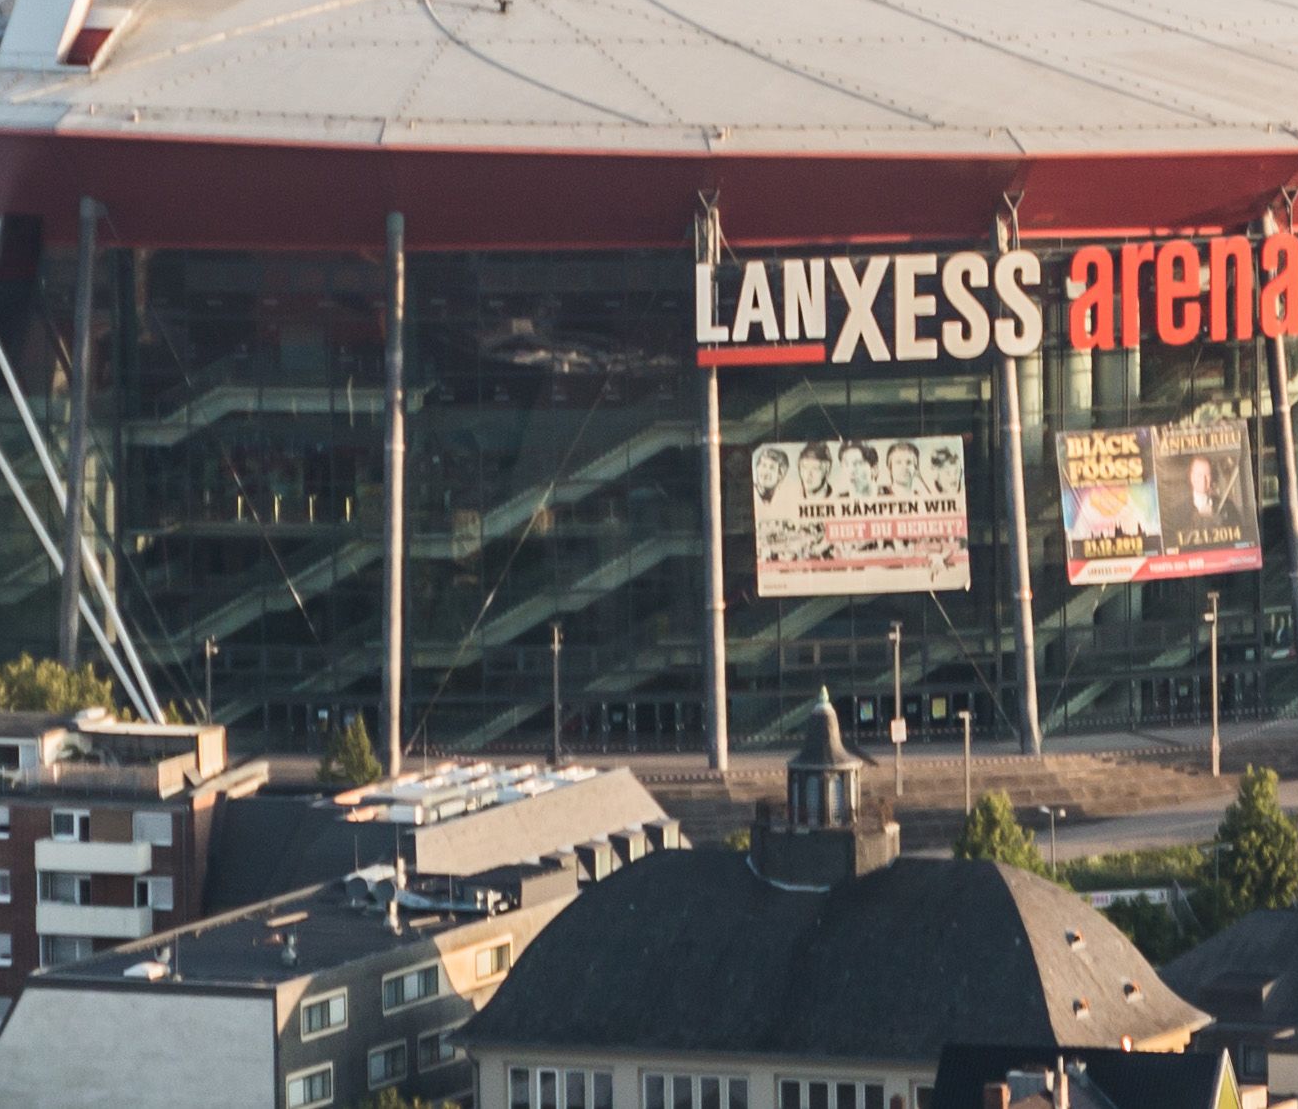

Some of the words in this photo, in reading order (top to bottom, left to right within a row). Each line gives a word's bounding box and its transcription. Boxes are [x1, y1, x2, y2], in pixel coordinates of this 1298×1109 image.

[696, 250, 1043, 364] LANXESS
[799, 504, 835, 518] HIER
[841, 500, 919, 517] KÄMPFEN
